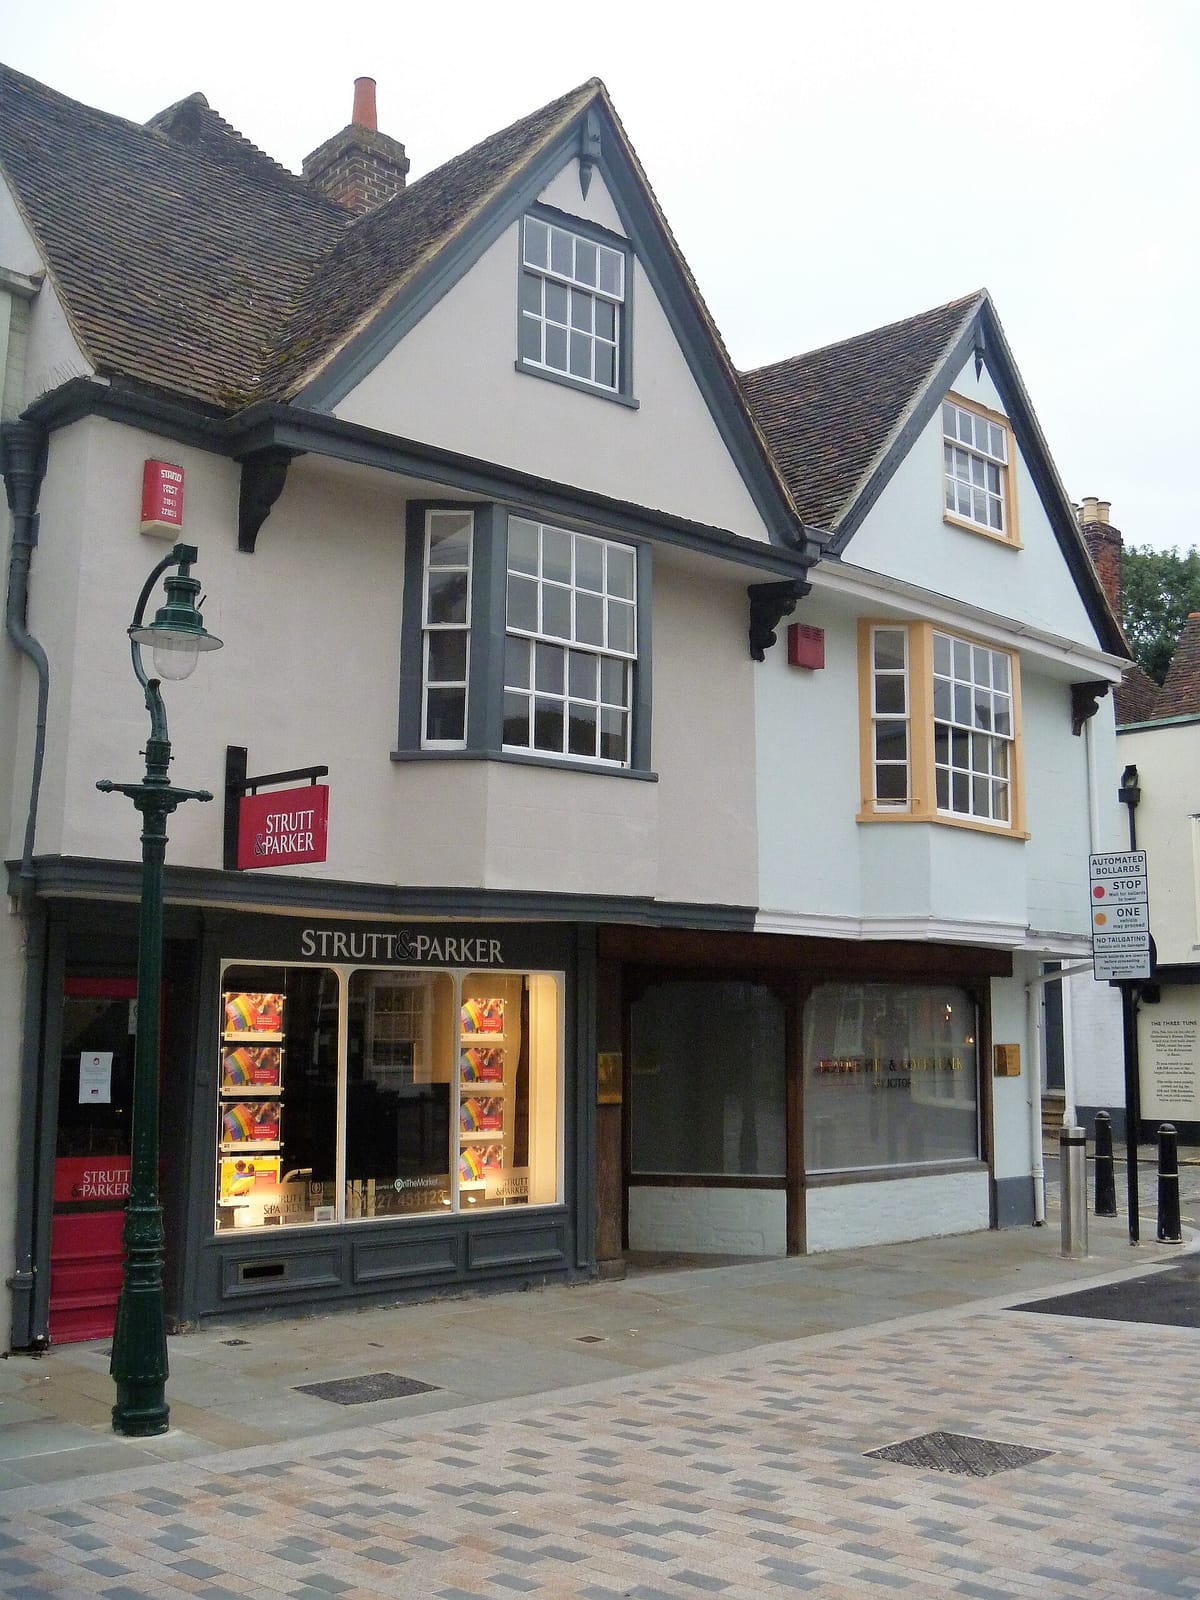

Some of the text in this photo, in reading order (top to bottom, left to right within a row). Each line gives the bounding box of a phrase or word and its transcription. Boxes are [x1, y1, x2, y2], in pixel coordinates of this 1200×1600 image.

[265, 809, 315, 834] STRUTT
[1092, 855, 1144, 866] AUTOMATED
[1096, 865, 1140, 875] BOLLARDS
[1113, 880, 1141, 890] STOP
[1116, 908, 1140, 917] ONE
[83, 1170, 131, 1184] STRUTT
